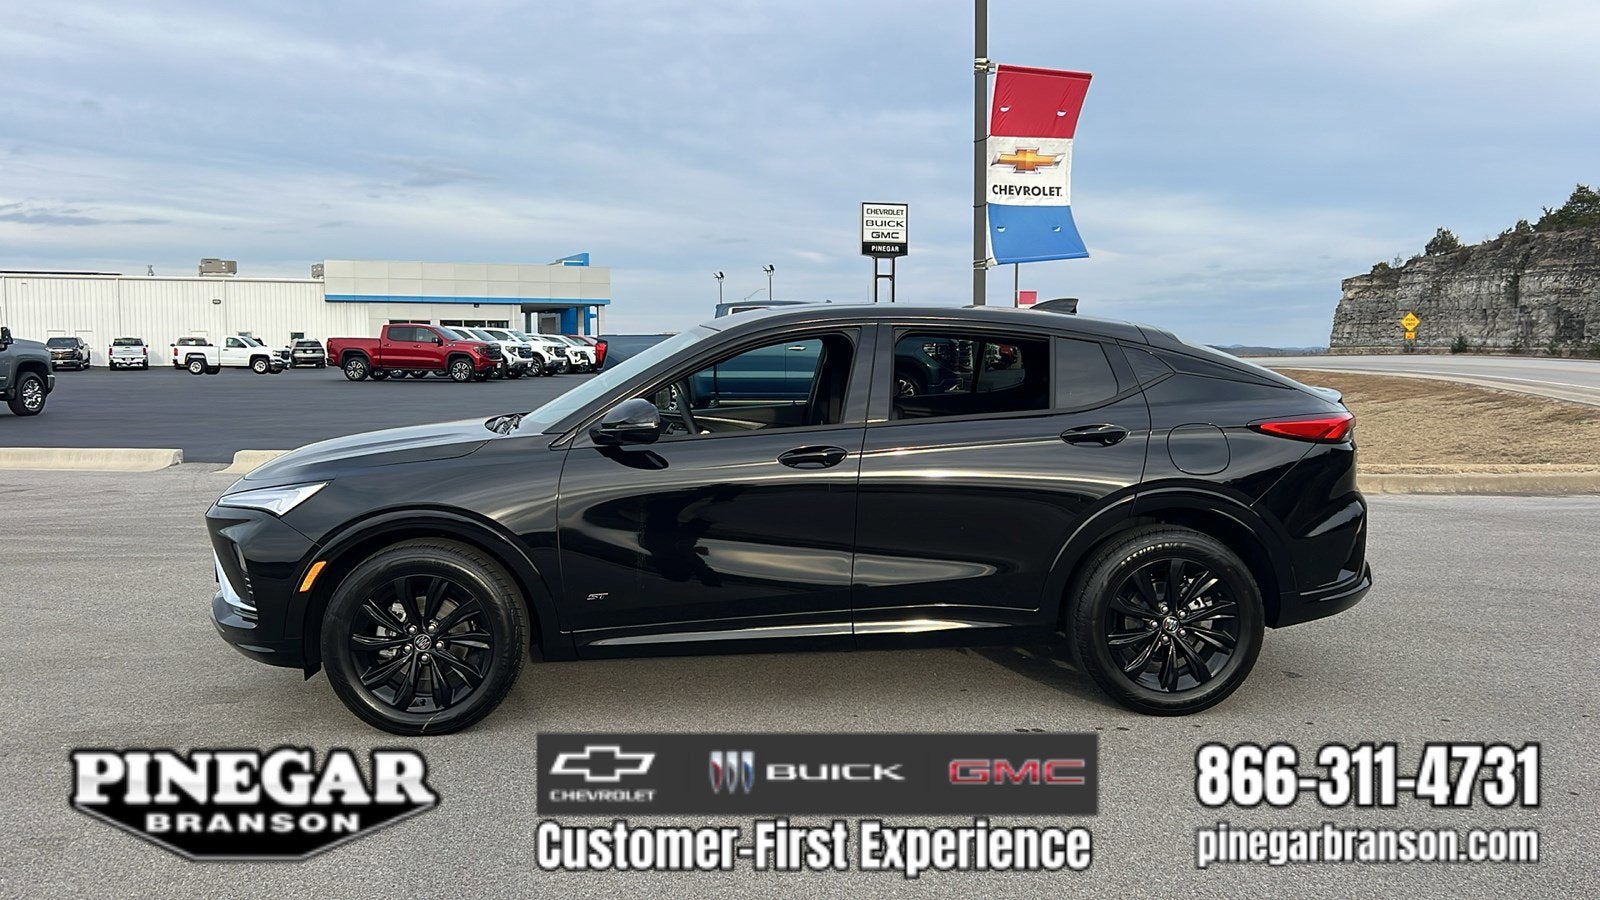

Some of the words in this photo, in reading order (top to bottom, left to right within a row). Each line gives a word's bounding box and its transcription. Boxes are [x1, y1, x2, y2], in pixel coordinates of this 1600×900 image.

[992, 184, 1062, 197] CHEVROLET
[866, 208, 904, 216] CHEVROLET
[865, 219, 904, 228] BUICK
[871, 231, 900, 239] GMC
